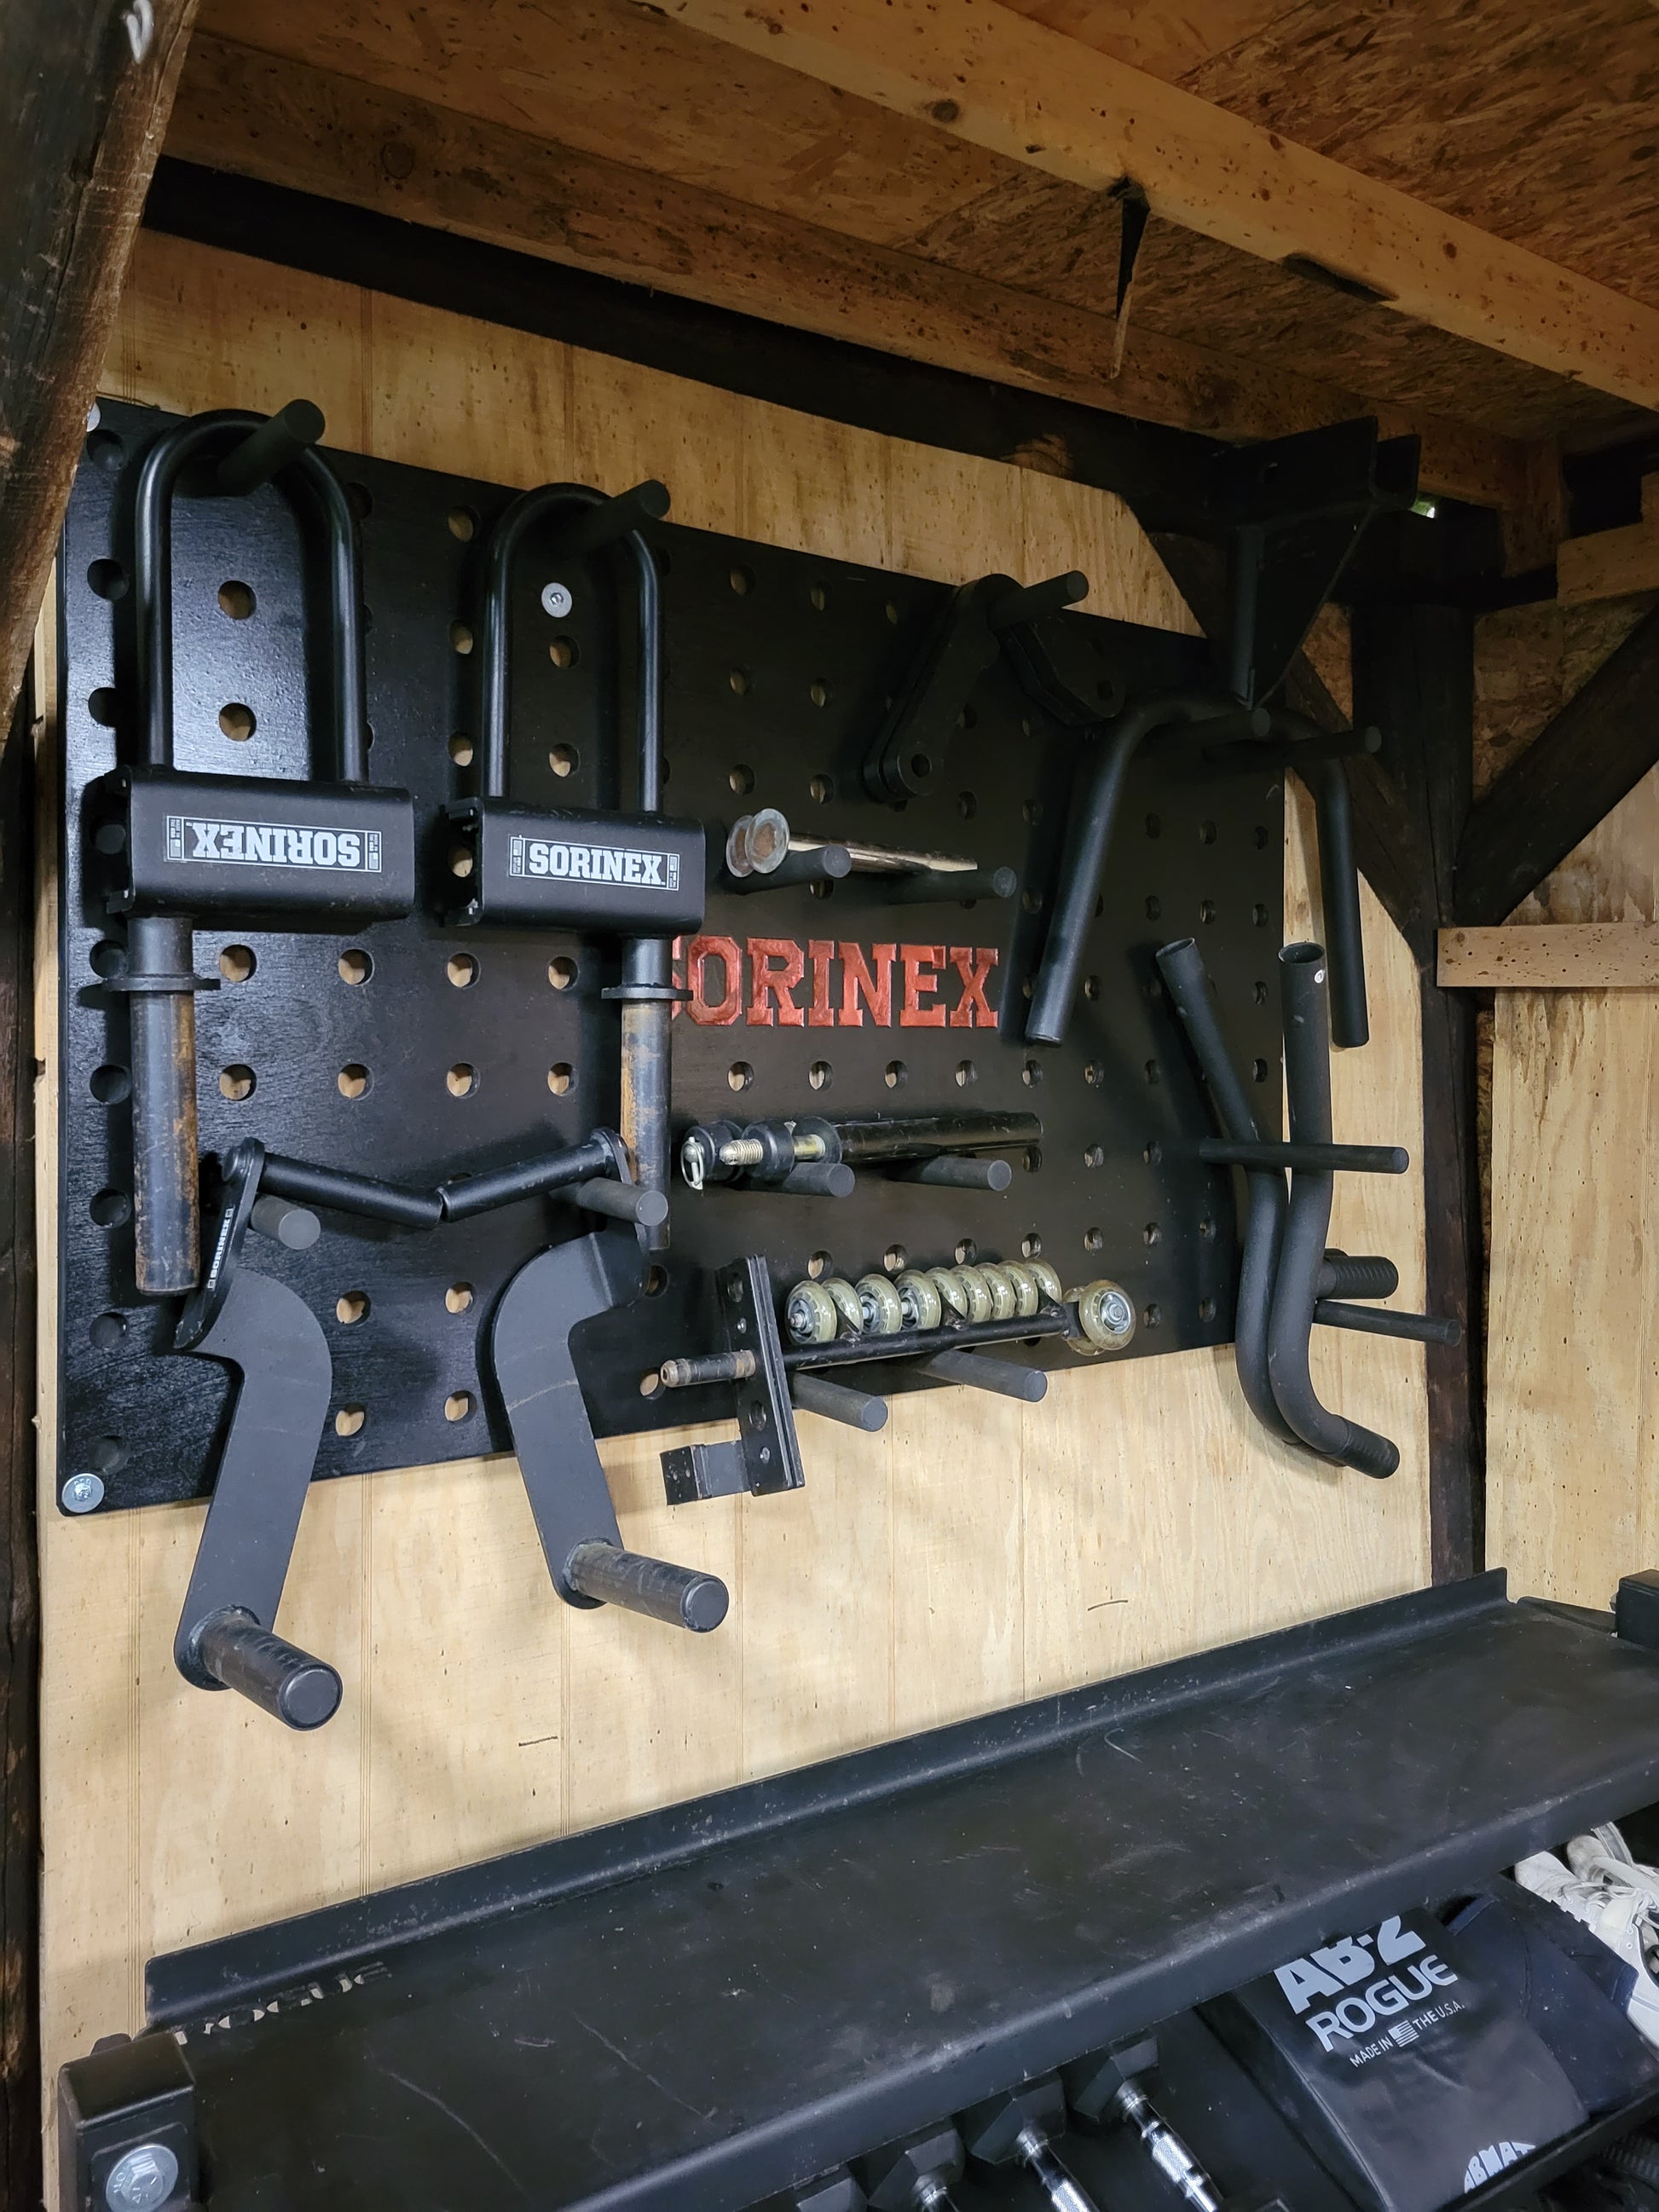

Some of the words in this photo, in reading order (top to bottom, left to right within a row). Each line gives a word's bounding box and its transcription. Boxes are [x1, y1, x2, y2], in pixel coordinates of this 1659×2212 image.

[192, 823, 361, 867] SORINEX
[529, 842, 662, 885] SORINEX
[672, 935, 998, 1028] ORINEX
[1274, 1915, 1426, 2014] AB-2
[1305, 1955, 1458, 2052] ROGUE
[1350, 2042, 1381, 2068] MADE
[1378, 2036, 1393, 2051] IN
[1412, 2011, 1438, 2030] THE
[1437, 2000, 1465, 2017] U.S.A.
